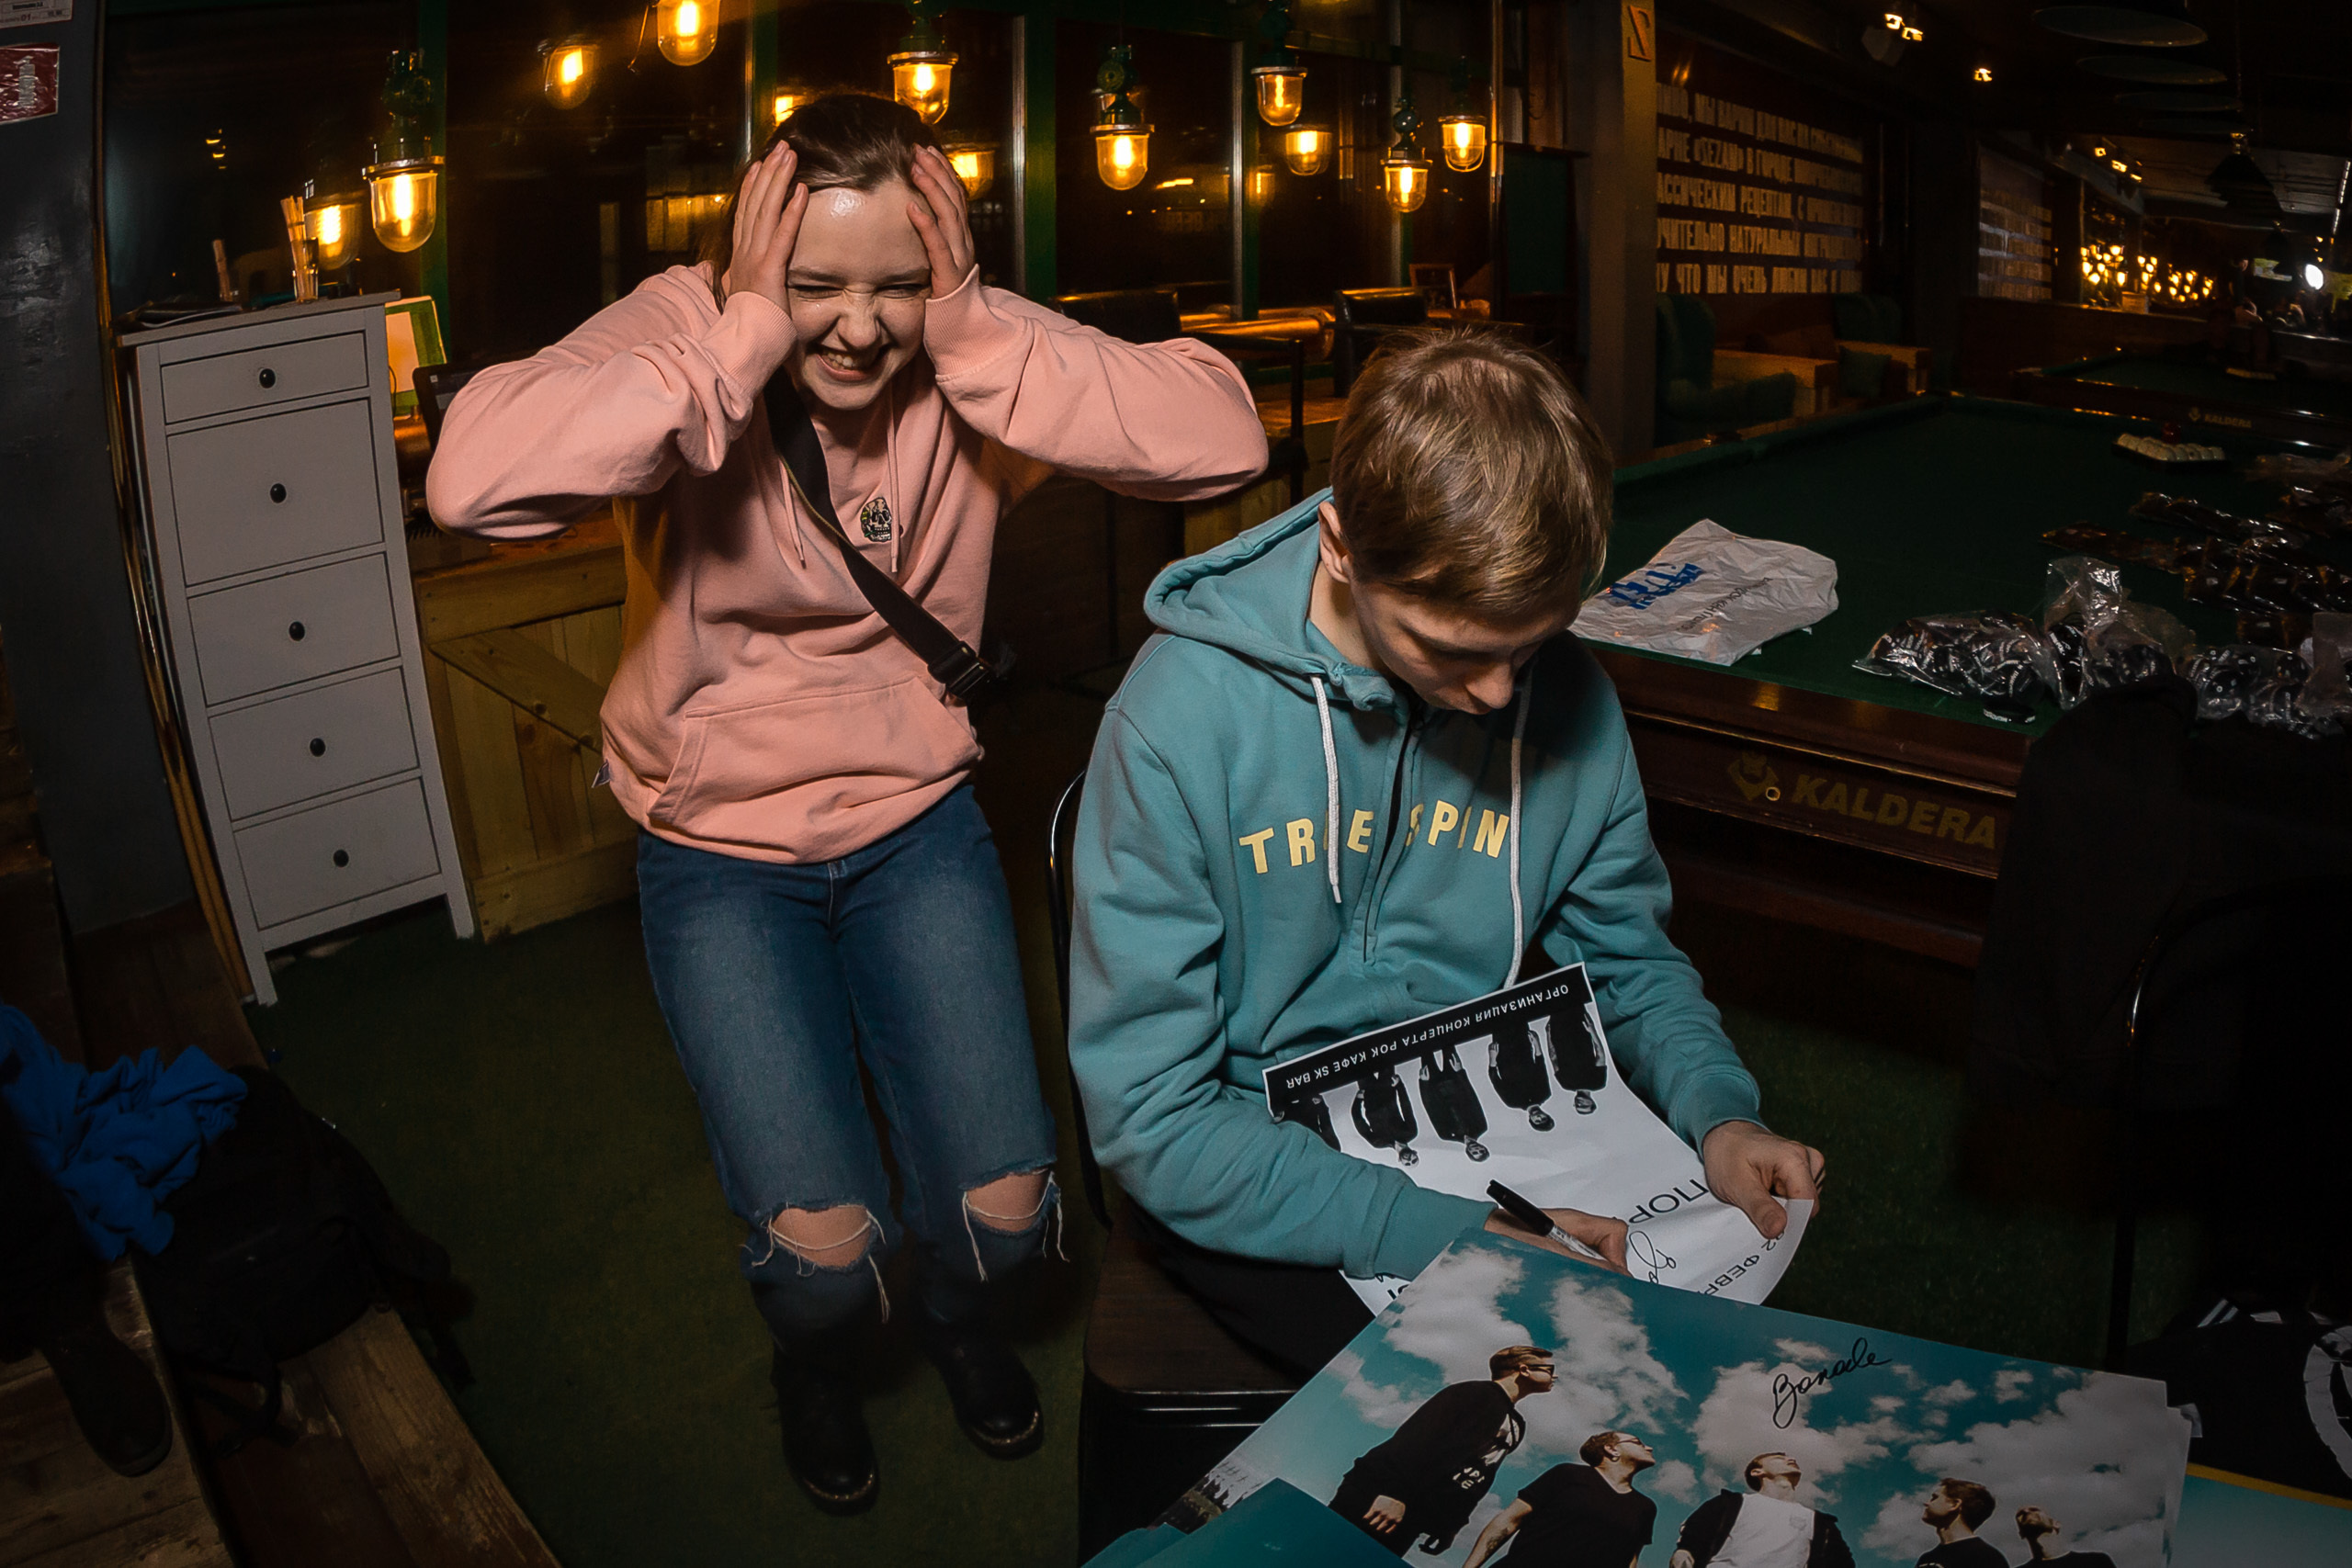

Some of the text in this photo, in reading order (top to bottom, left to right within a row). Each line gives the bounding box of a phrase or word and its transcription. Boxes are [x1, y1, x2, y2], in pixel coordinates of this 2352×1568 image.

[1676, 263, 1702, 293] ЧТО
[1732, 265, 1768, 294] ОЧЕНЬ
[1238, 809, 1374, 874] TRE
[1791, 773, 1996, 850] KALDERA
[1286, 984, 1569, 1089] ОРГАНИЗАЦИЯ КОНЦЕРТА РОК КАФЕ SK BAR
[1698, 1254, 1760, 1295] ФЕВР
